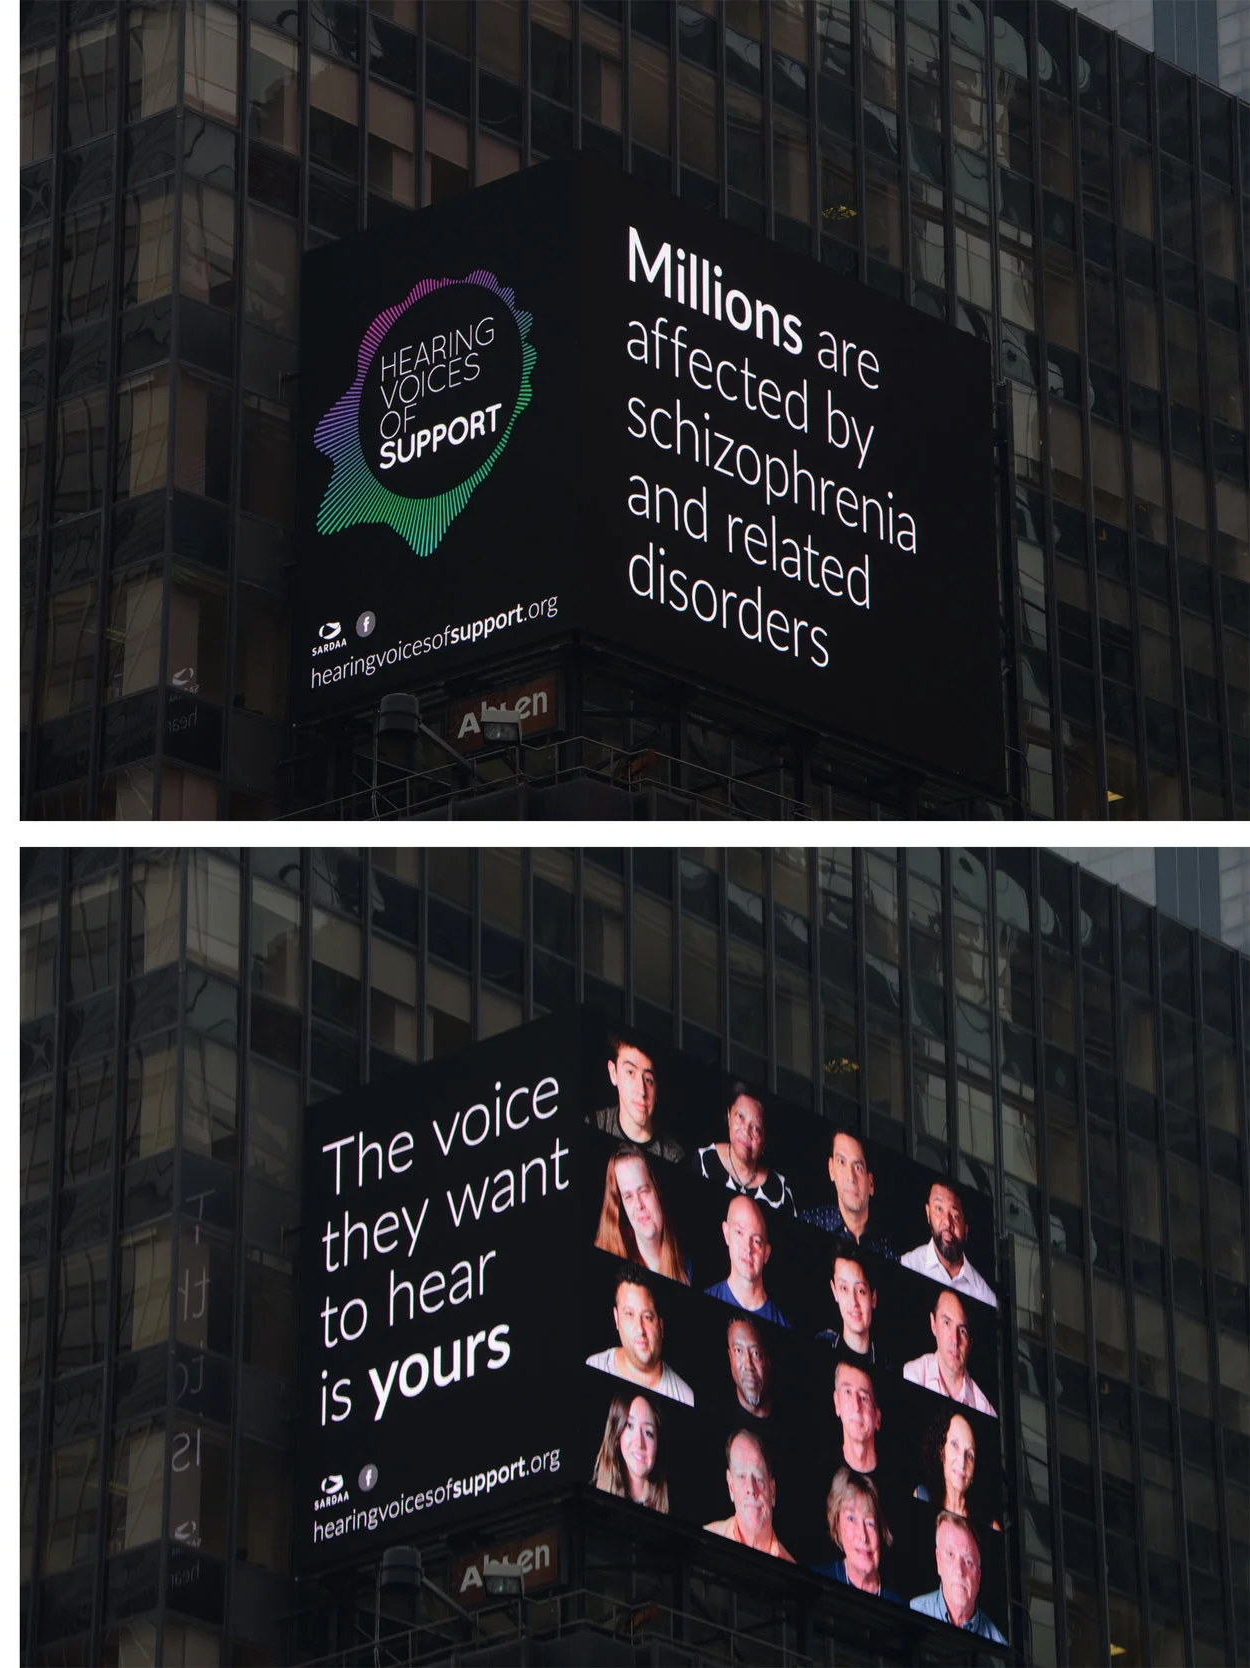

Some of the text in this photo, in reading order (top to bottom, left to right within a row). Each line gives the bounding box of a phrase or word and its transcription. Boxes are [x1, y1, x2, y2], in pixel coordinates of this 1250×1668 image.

[381, 316, 495, 382] HEARING
[628, 225, 880, 390] Millions are
[379, 402, 417, 440] OF
[380, 352, 481, 410] VOICES
[626, 316, 875, 470] affected by
[379, 402, 503, 470] SUPPORT
[627, 396, 917, 555] schizophrenia
[627, 474, 870, 610] and related
[311, 595, 558, 689] hearingvoicesofsupport.org
[311, 637, 347, 657] SARDAA
[628, 541, 829, 668] disorders
[322, 1076, 559, 1196] The voice
[321, 1137, 570, 1273] they want
[320, 1249, 497, 1349] to hear
[321, 1323, 511, 1426] is yours
[313, 1448, 561, 1543] hearingvoicesofsupport.org
[314, 1490, 350, 1512] SARDAA
